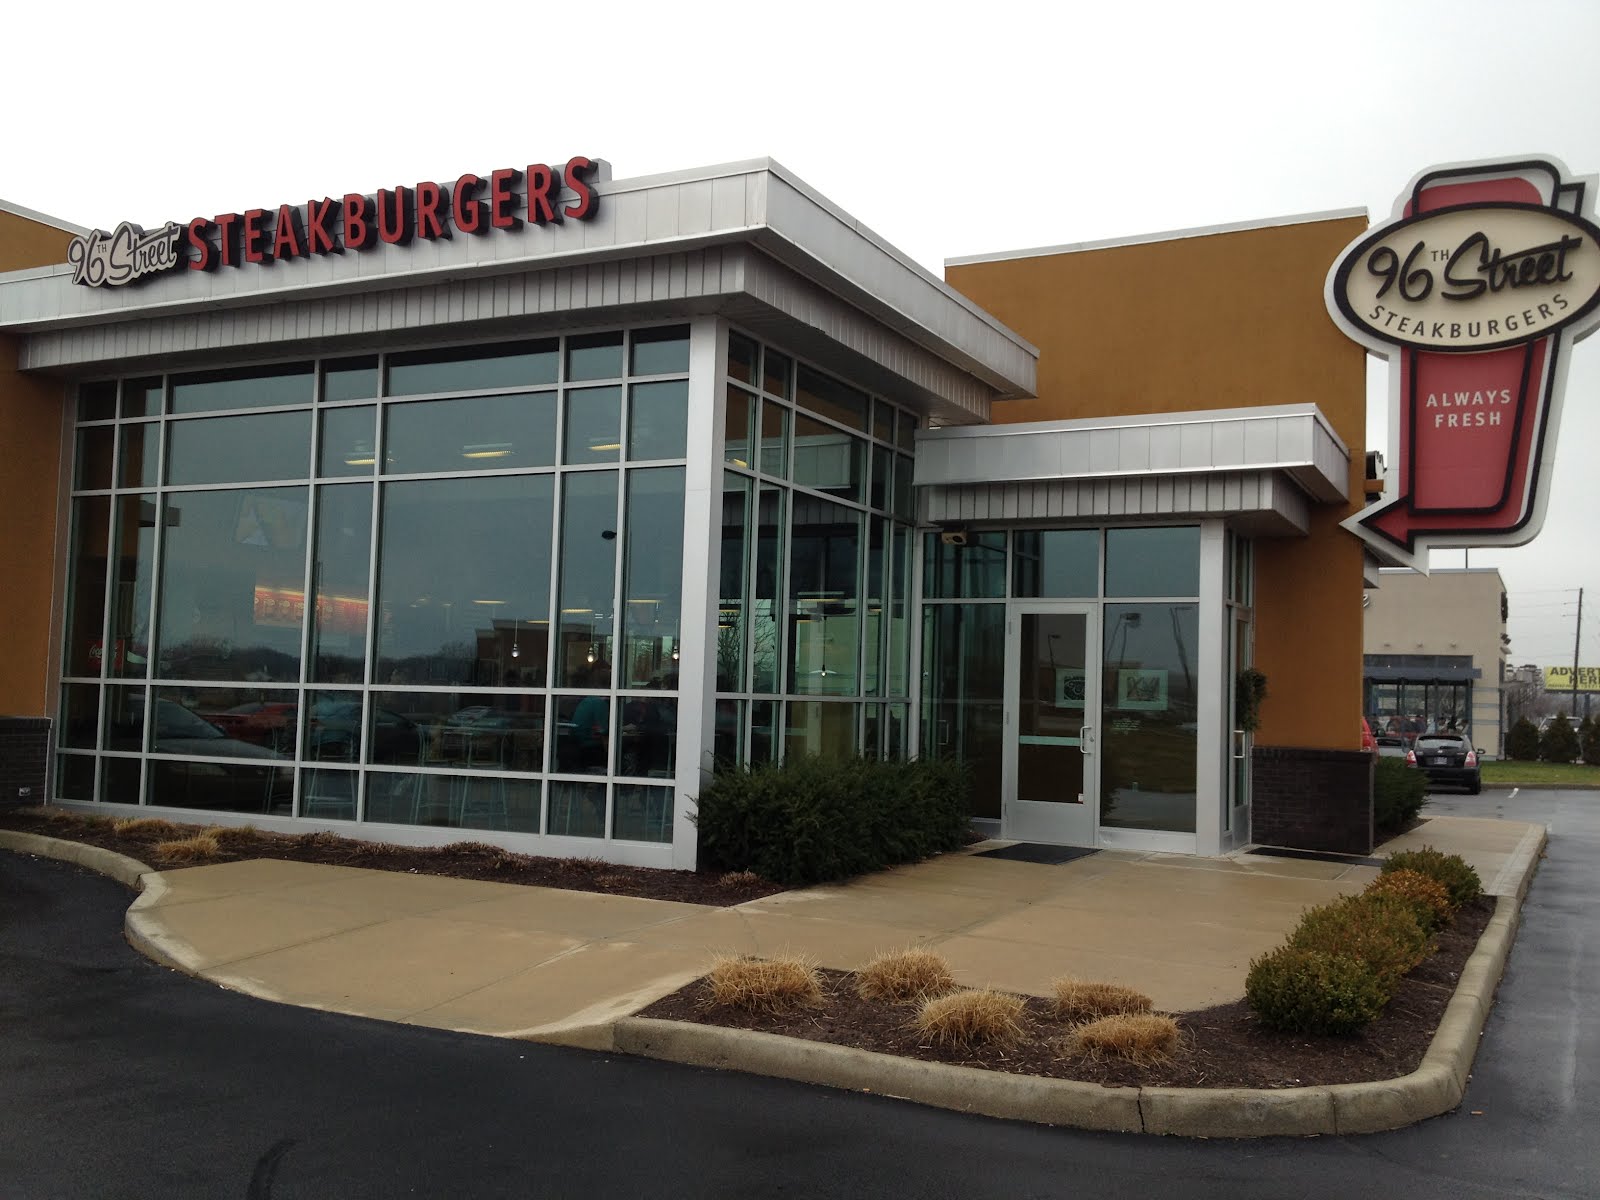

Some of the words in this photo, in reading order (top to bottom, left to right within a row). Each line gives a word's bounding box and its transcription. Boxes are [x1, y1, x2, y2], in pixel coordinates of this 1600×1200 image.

[109, 225, 180, 281] Street
[188, 156, 594, 271] STEAKBURGERS
[1441, 231, 1583, 301] Street
[1369, 293, 1568, 338] STEAKBURGERS
[1426, 389, 1511, 407] ALWAYS
[1435, 411, 1500, 428] FRESH
[1569, 675, 1600, 684] HER
